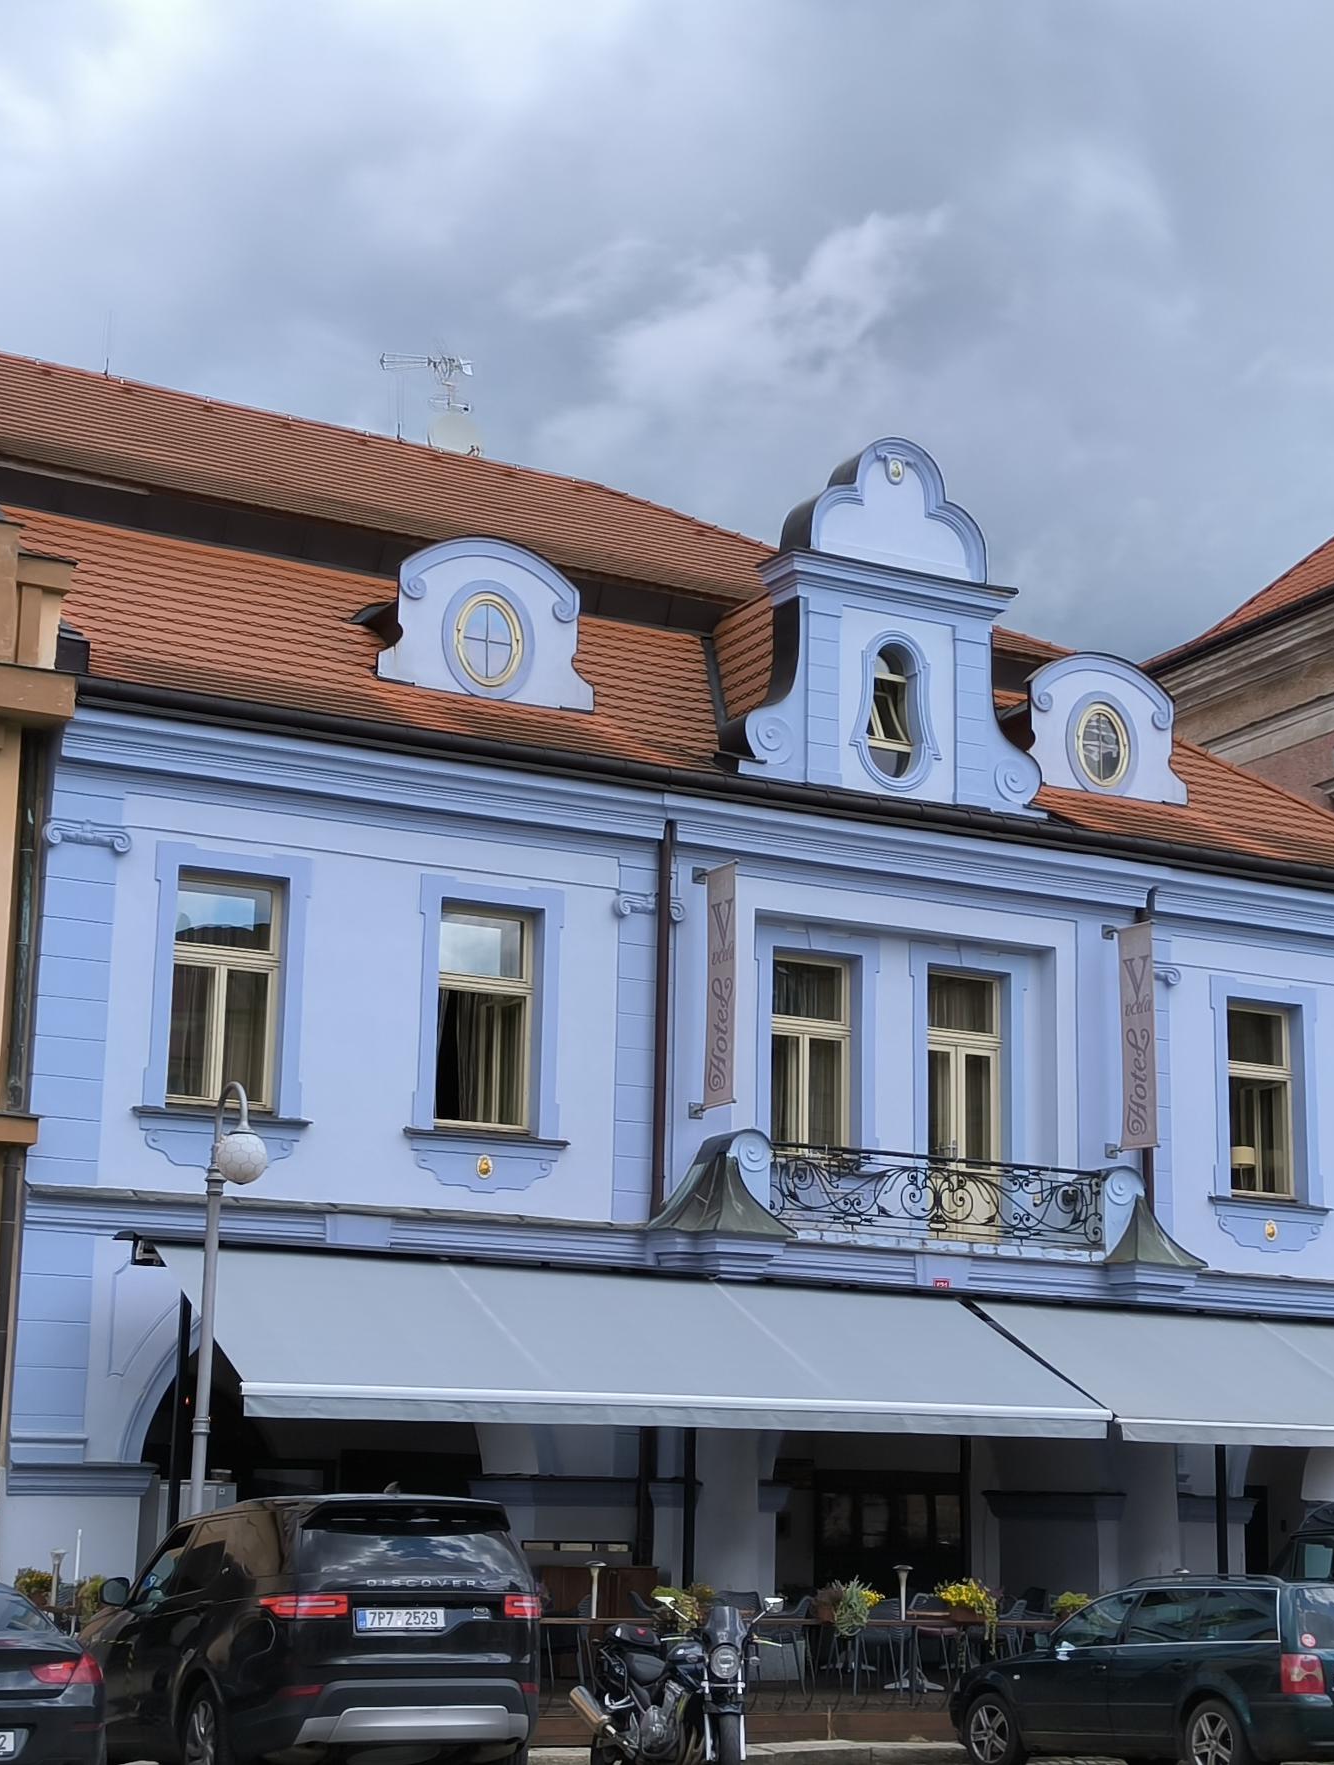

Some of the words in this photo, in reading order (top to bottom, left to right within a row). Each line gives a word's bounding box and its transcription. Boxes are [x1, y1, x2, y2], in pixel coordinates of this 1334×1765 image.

[710, 898, 734, 947] V
[1122, 954, 1150, 1001] V
[366, 1579, 489, 1587] DISCOVERY
[368, 1611, 394, 1626] 7P7
[405, 1611, 438, 1626] 2529
